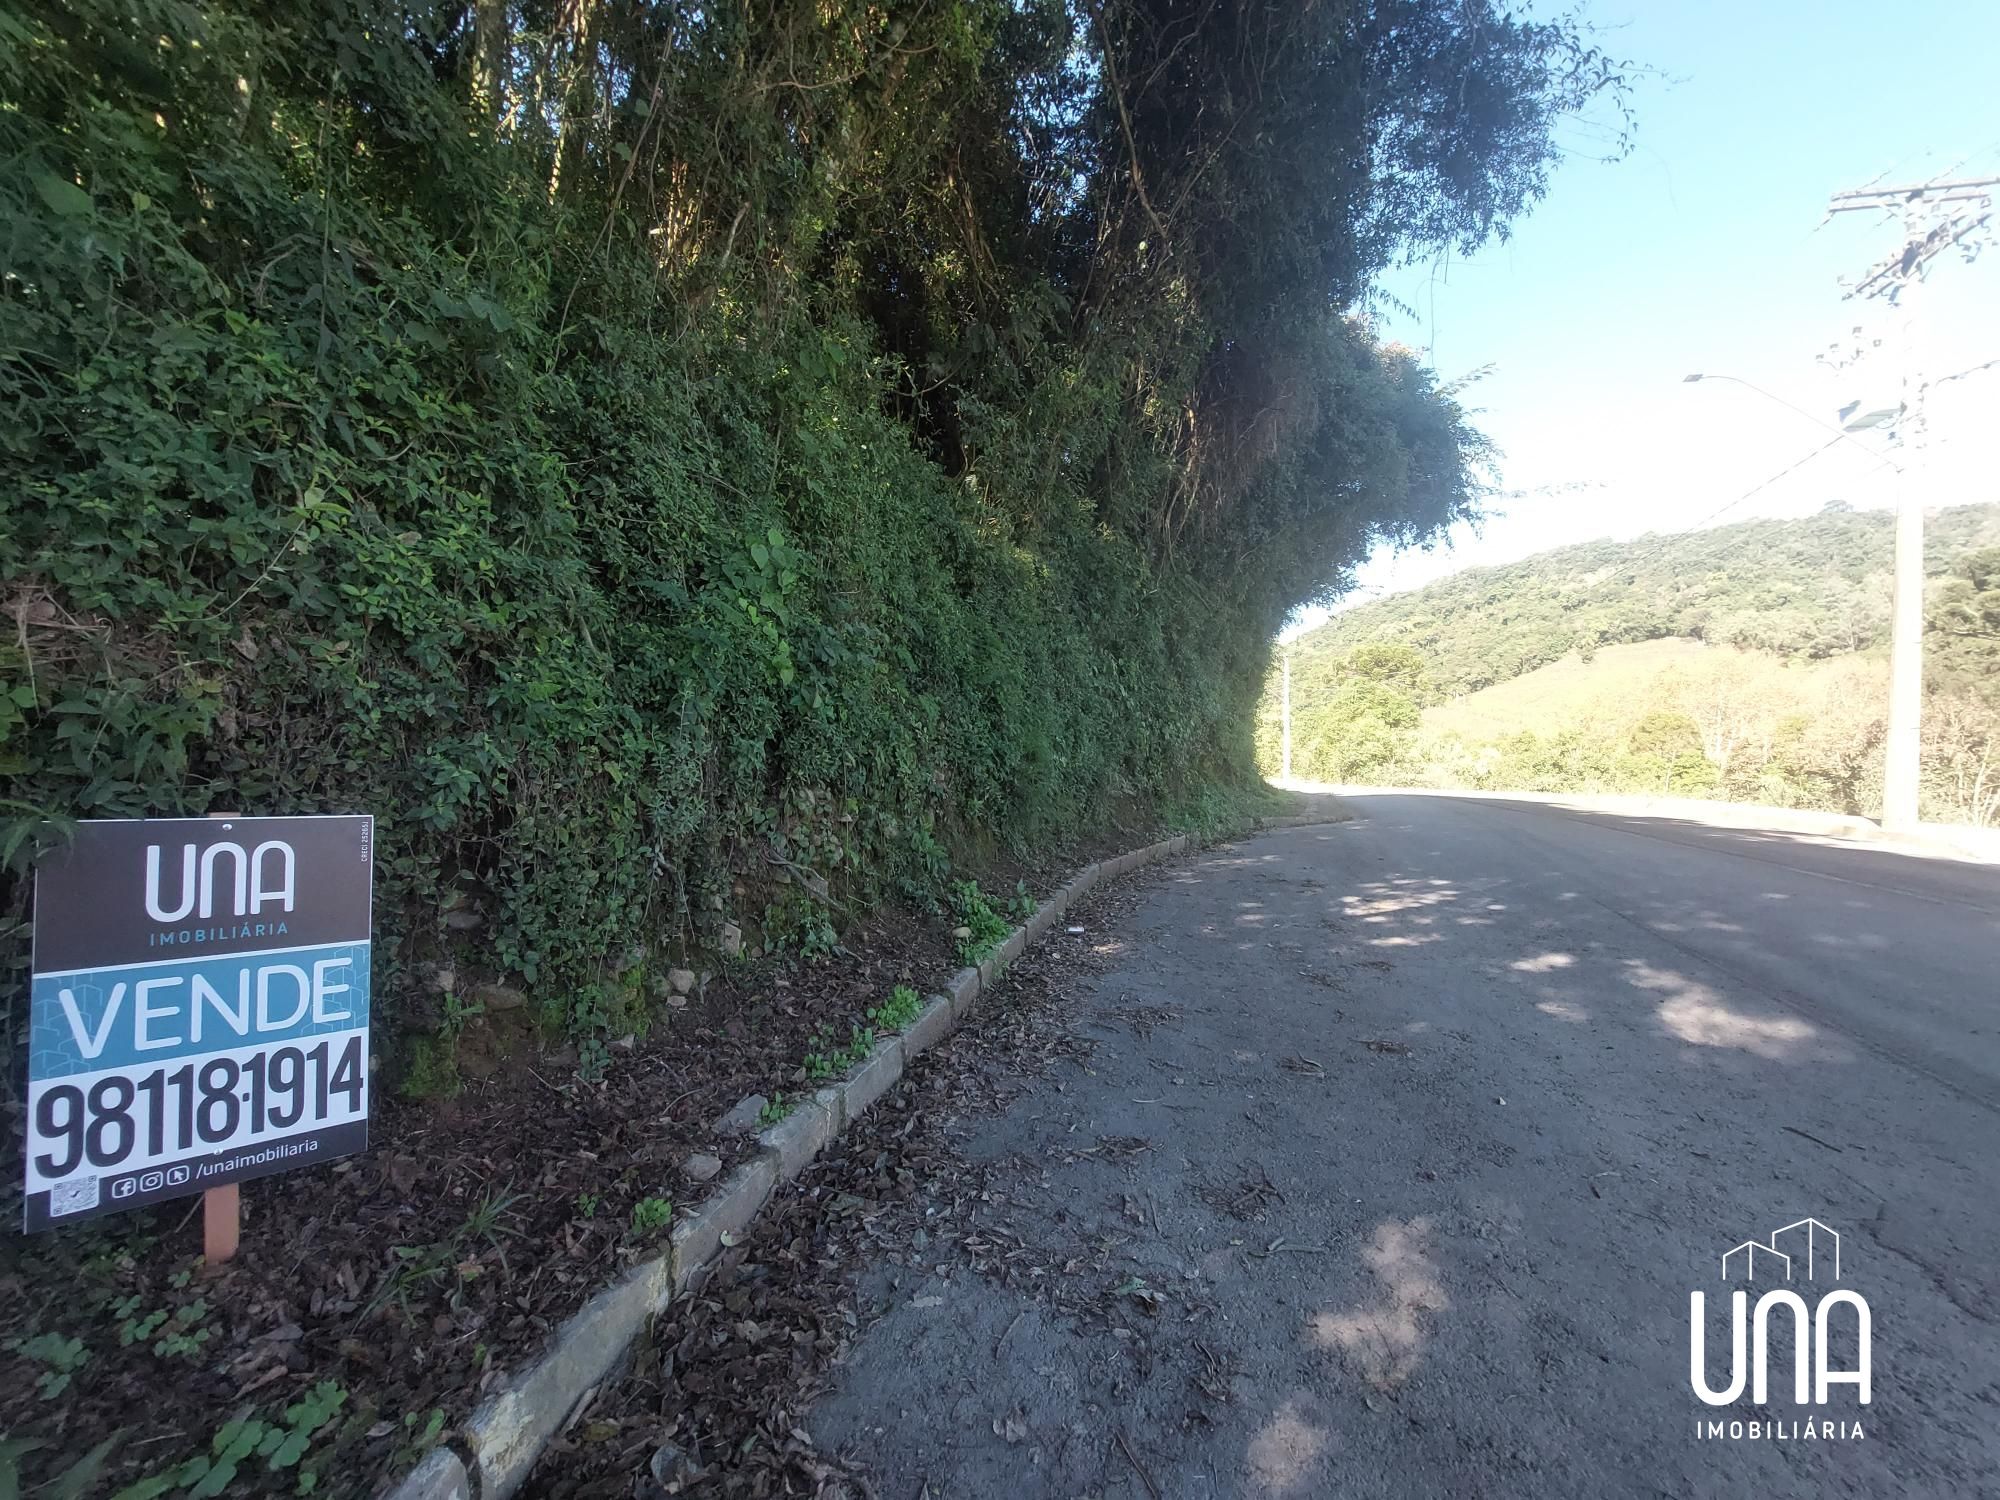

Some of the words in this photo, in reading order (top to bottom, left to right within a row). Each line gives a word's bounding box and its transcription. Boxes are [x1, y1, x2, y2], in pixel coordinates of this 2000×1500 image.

[145, 840, 295, 922] UNA
[150, 921, 288, 946] IMOBILIÁRIA
[58, 957, 352, 1059] VENDE
[196, 1139, 318, 1179] /unaimobiliaria
